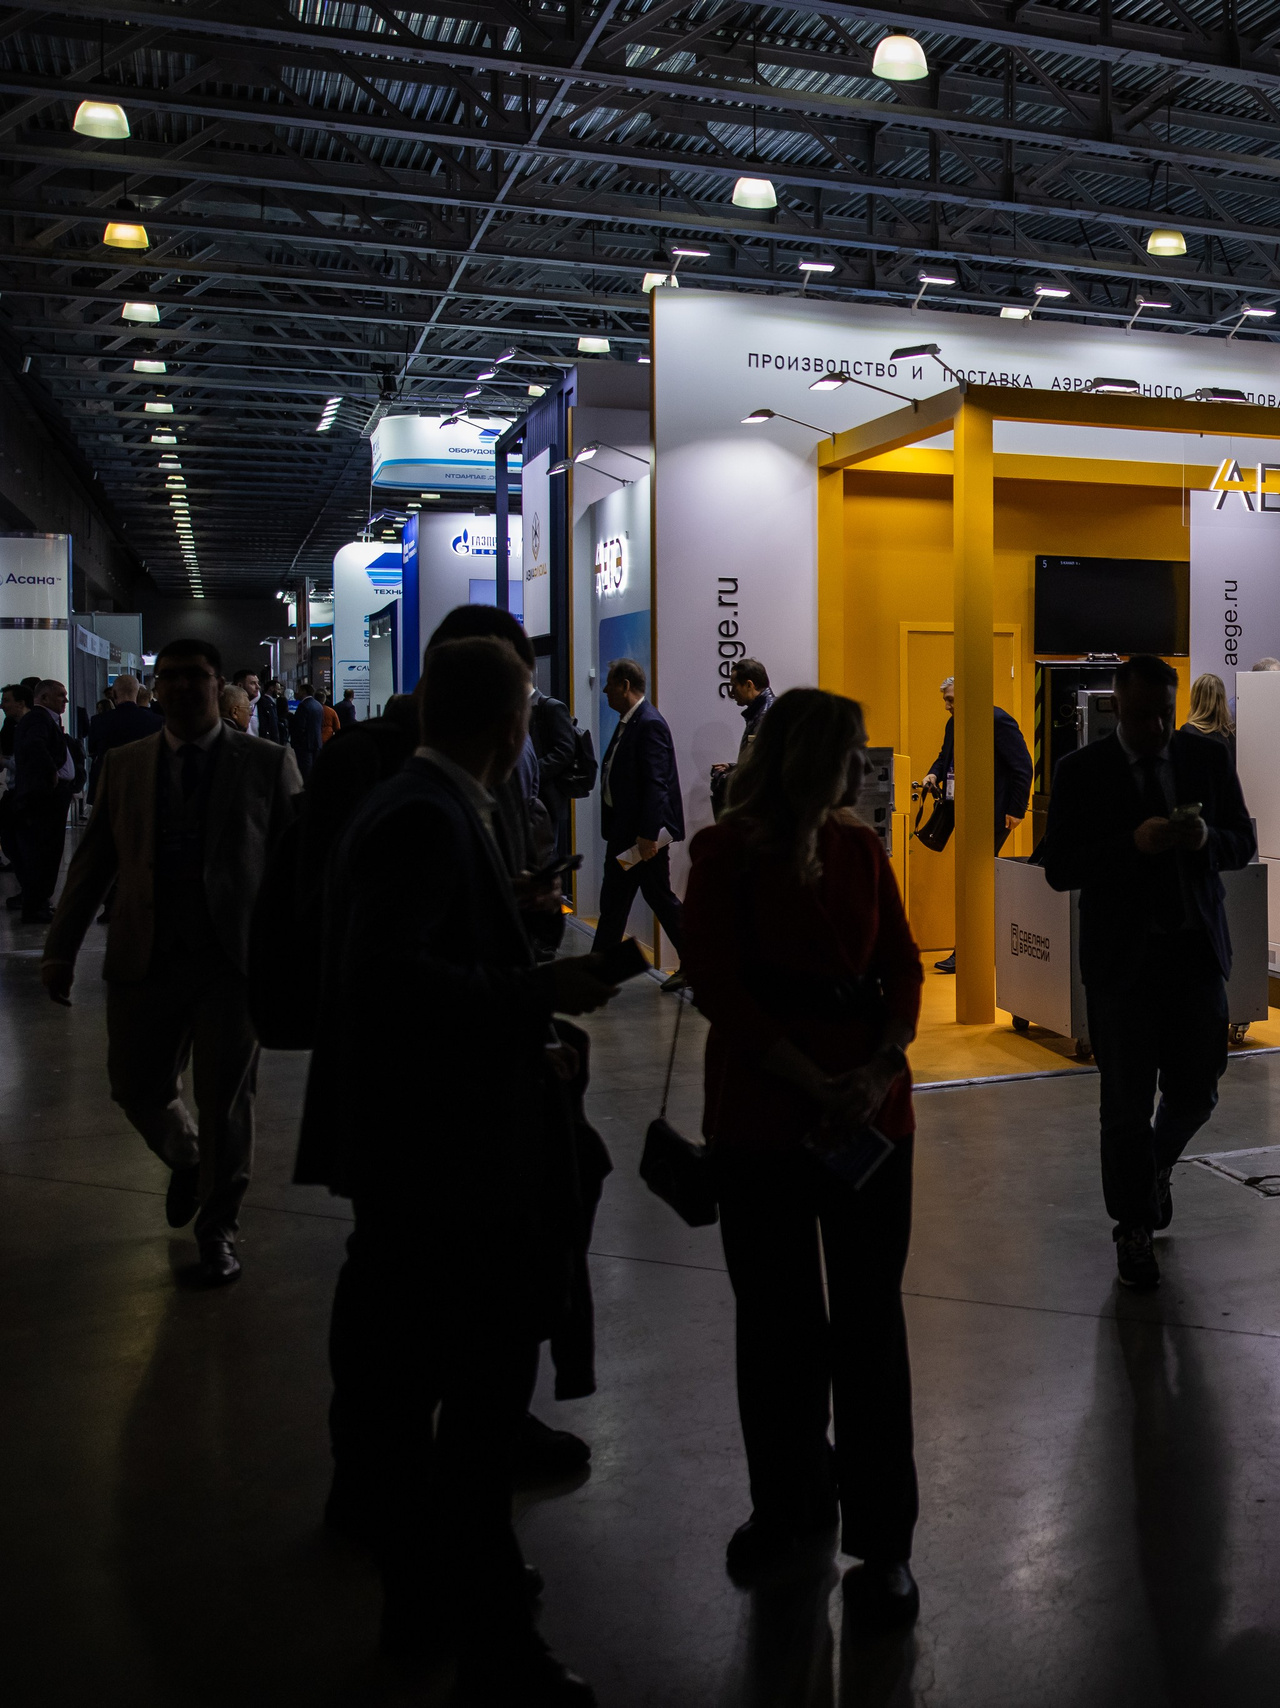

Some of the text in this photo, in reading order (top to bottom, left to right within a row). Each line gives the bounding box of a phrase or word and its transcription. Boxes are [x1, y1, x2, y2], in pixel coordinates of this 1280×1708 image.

[748, 353, 897, 377] ПРОИЗВОДСТВО
[912, 366, 922, 380] И
[942, 370, 1033, 389] ПОСТАВКА
[1051, 376, 1183, 399] АЭРОНОГО
[6, 573, 55, 585] Асана
[718, 577, 746, 699] aege.ru
[1224, 580, 1243, 666] aege.ru
[1020, 930, 1050, 949] СДЕЛАНО
